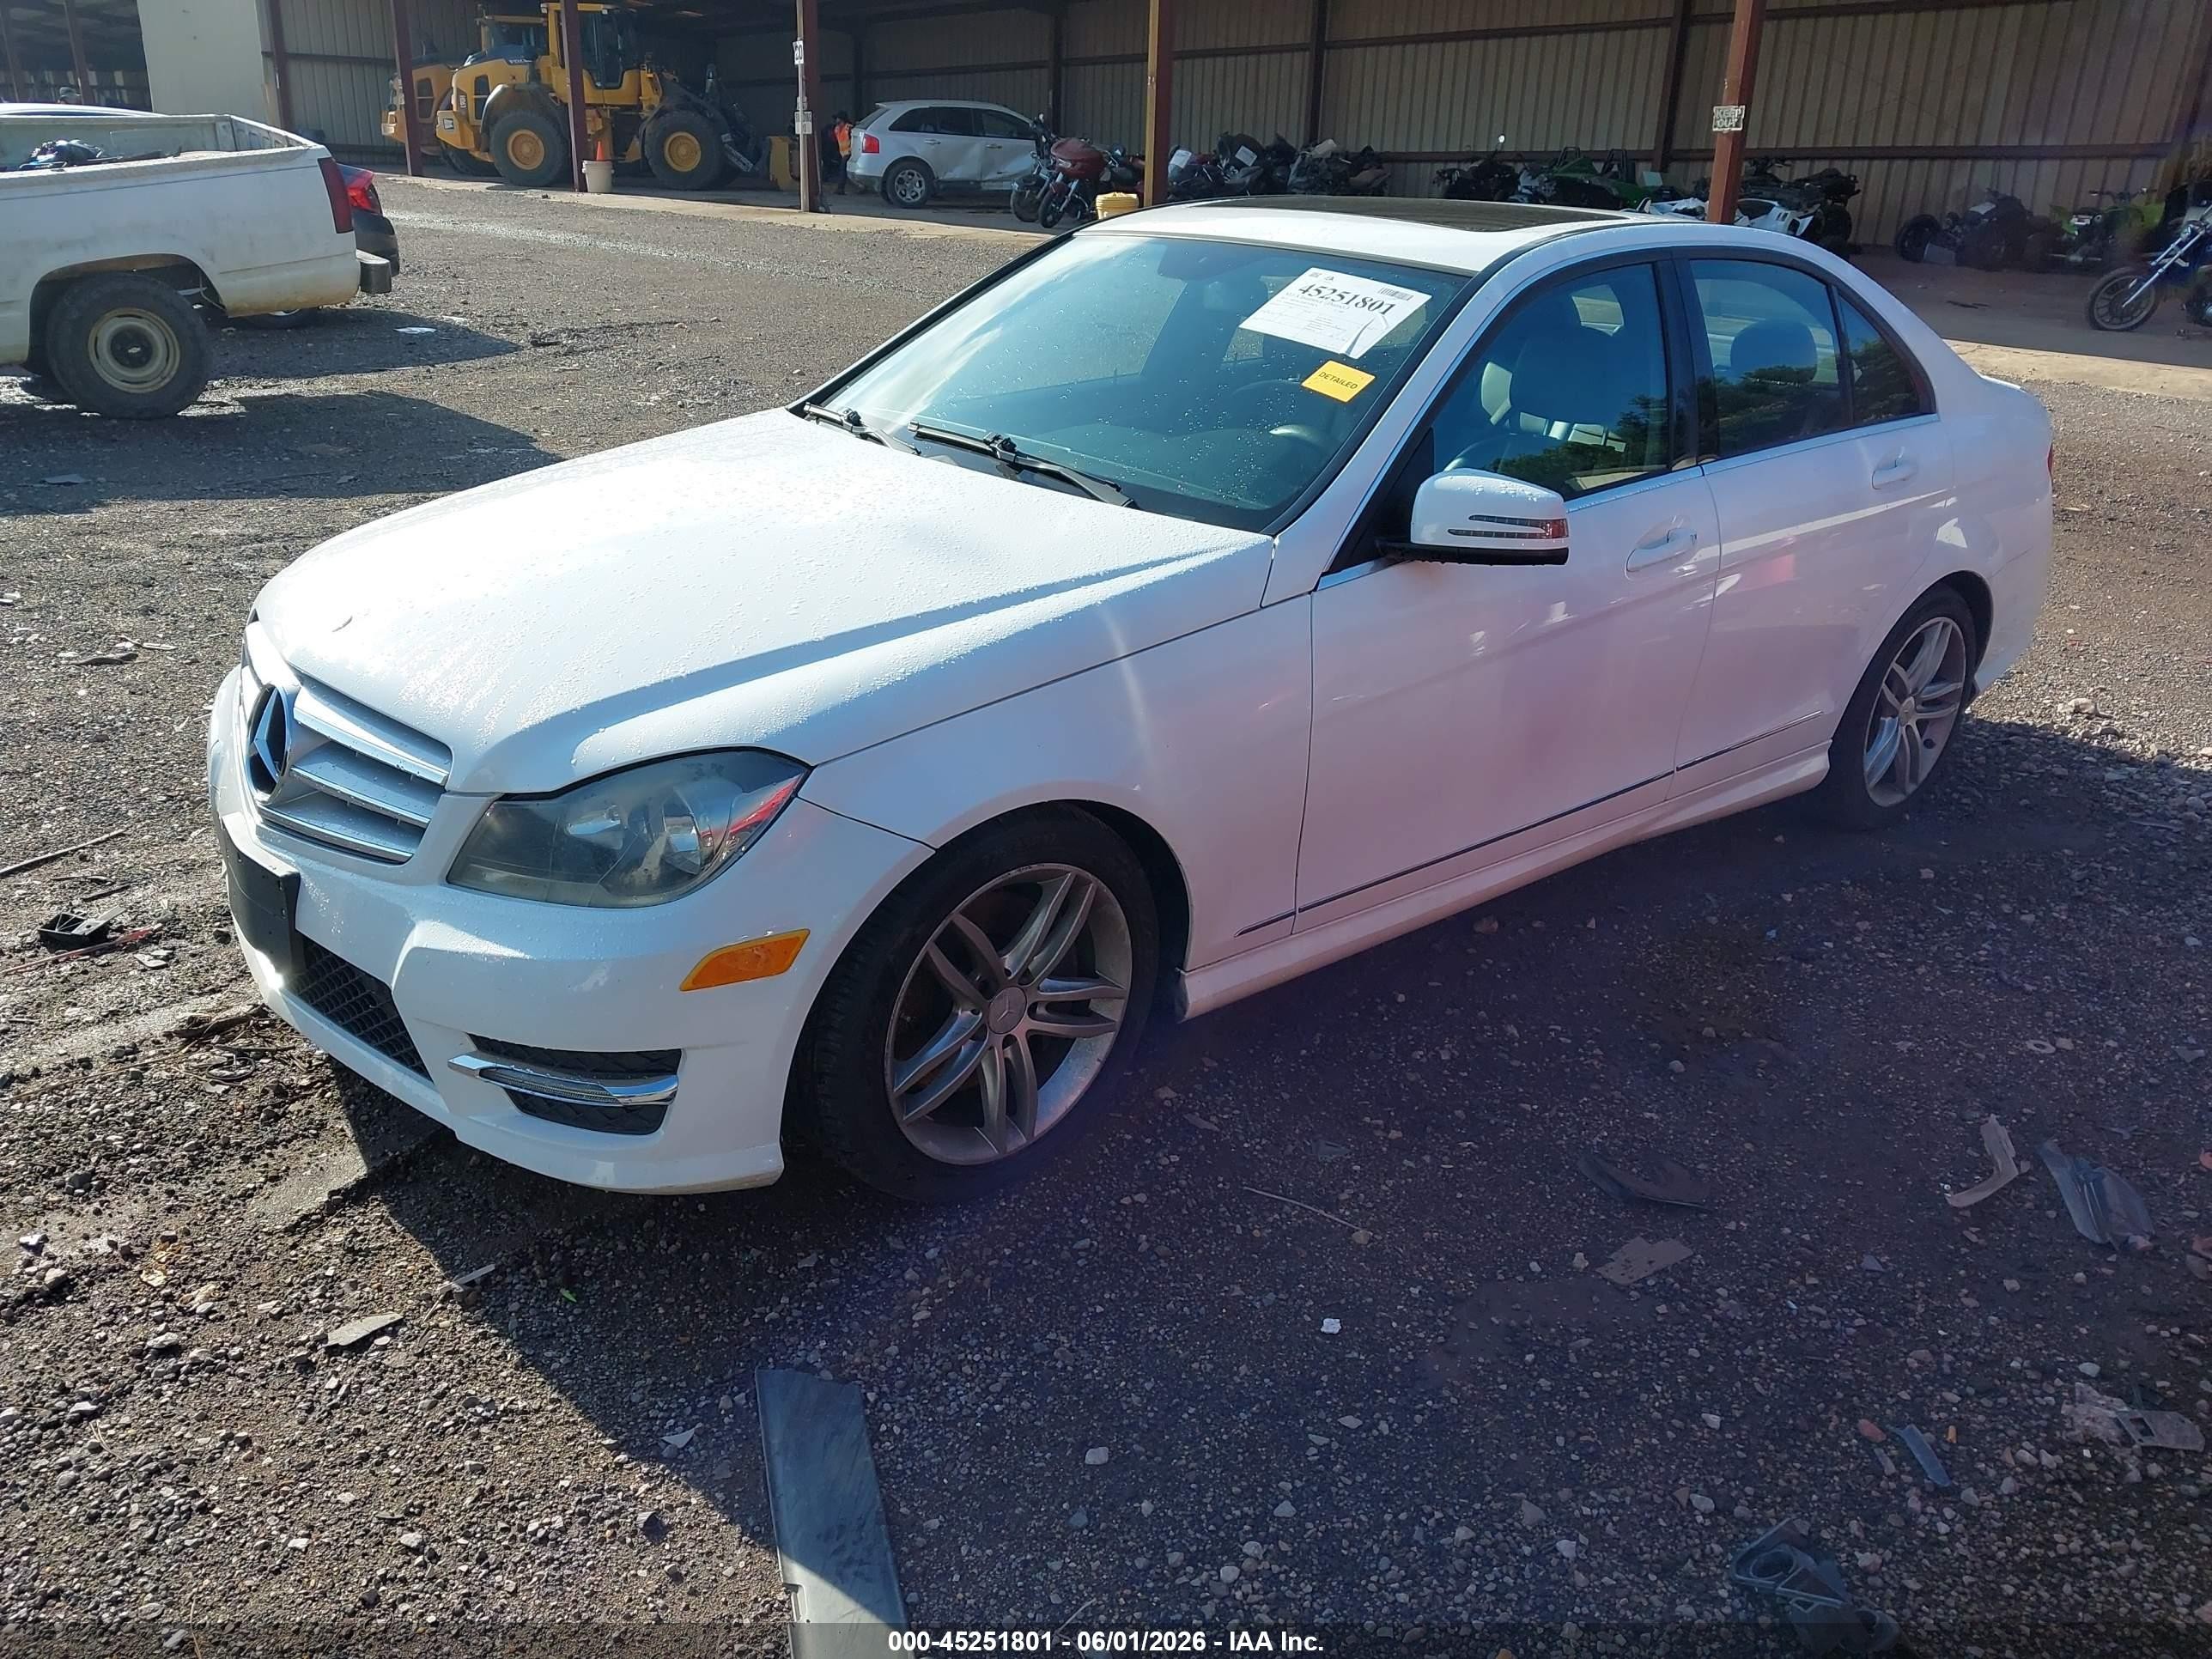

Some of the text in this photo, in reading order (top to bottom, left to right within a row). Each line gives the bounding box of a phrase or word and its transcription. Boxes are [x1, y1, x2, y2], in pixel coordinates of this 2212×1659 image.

[1717, 109, 1741, 118] KEEP
[1717, 118, 1738, 128] OUT
[1297, 283, 1396, 315] 45251801
[1318, 371, 1358, 390] DETAILED
